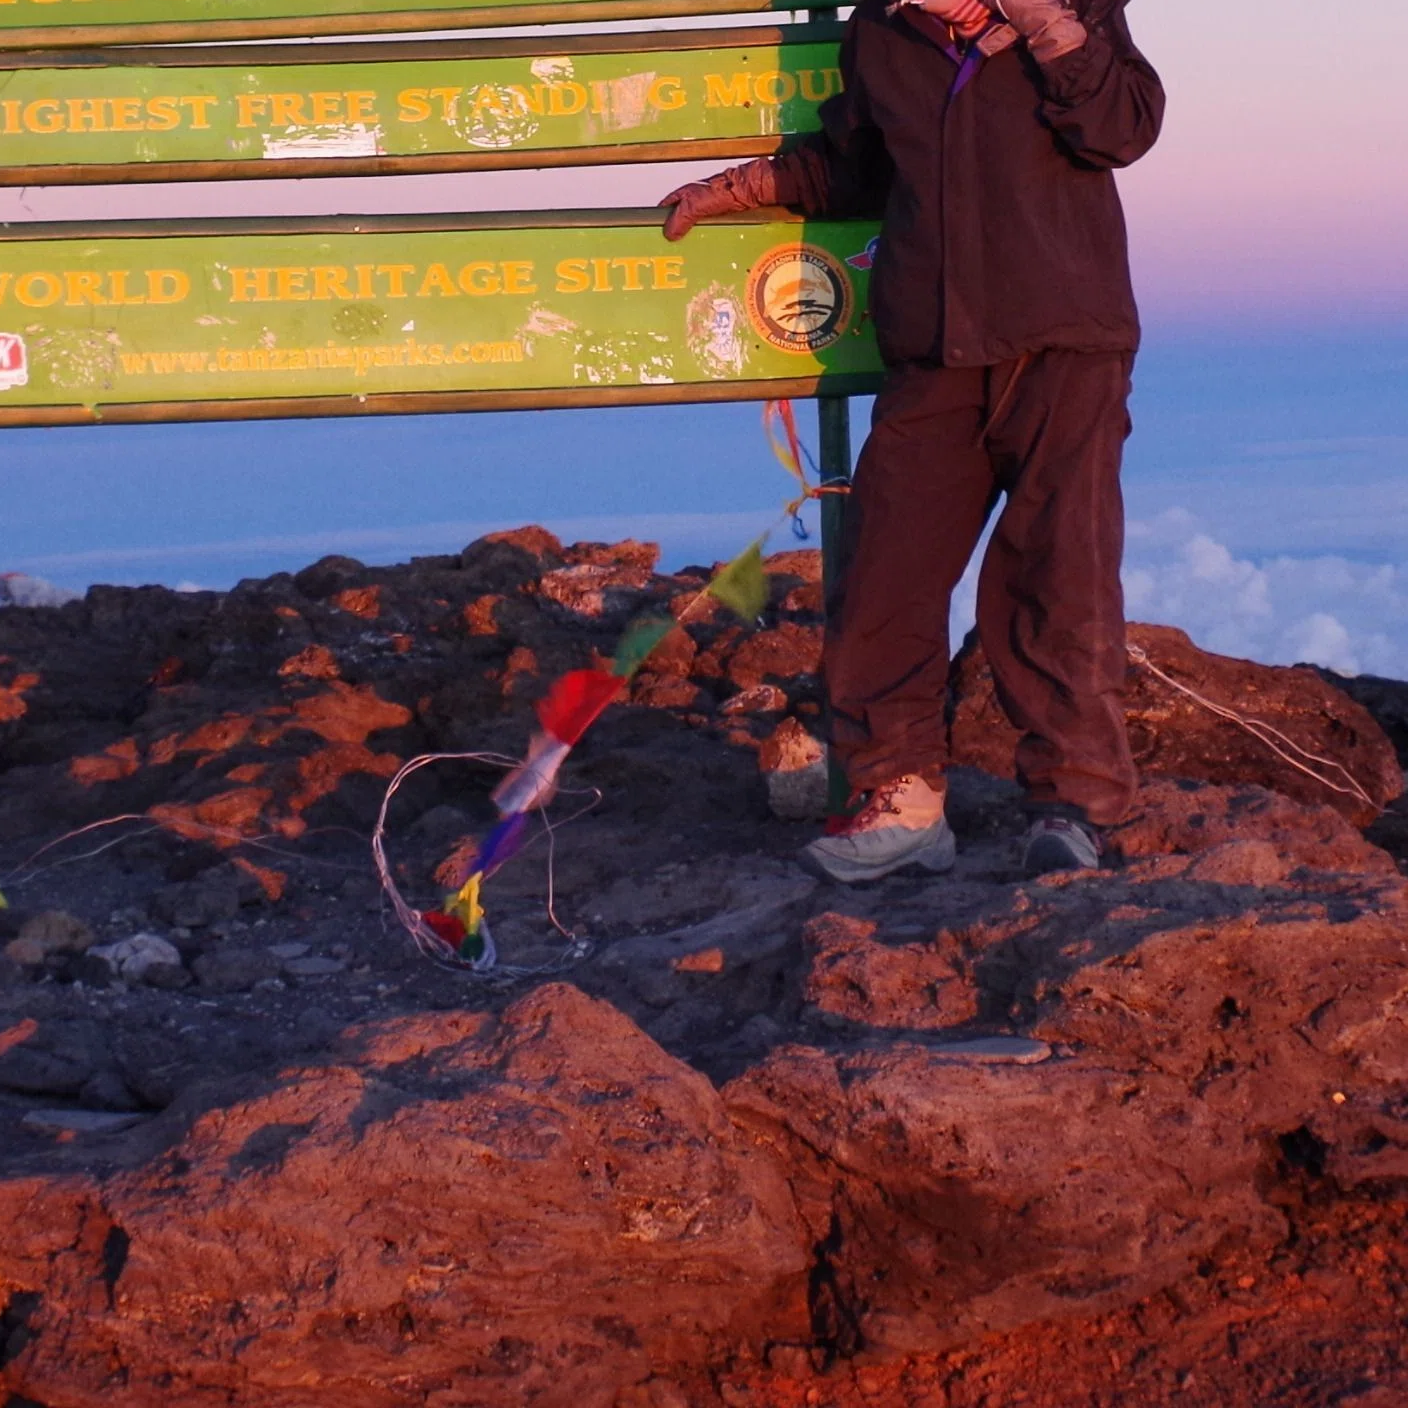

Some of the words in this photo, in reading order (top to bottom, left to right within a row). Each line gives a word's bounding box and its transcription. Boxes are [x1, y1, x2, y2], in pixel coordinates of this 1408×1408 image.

[235, 90, 382, 129] FREE
[396, 75, 688, 125] STANDIG
[228, 259, 538, 303] HERITAGE
[554, 255, 688, 293] SITE
